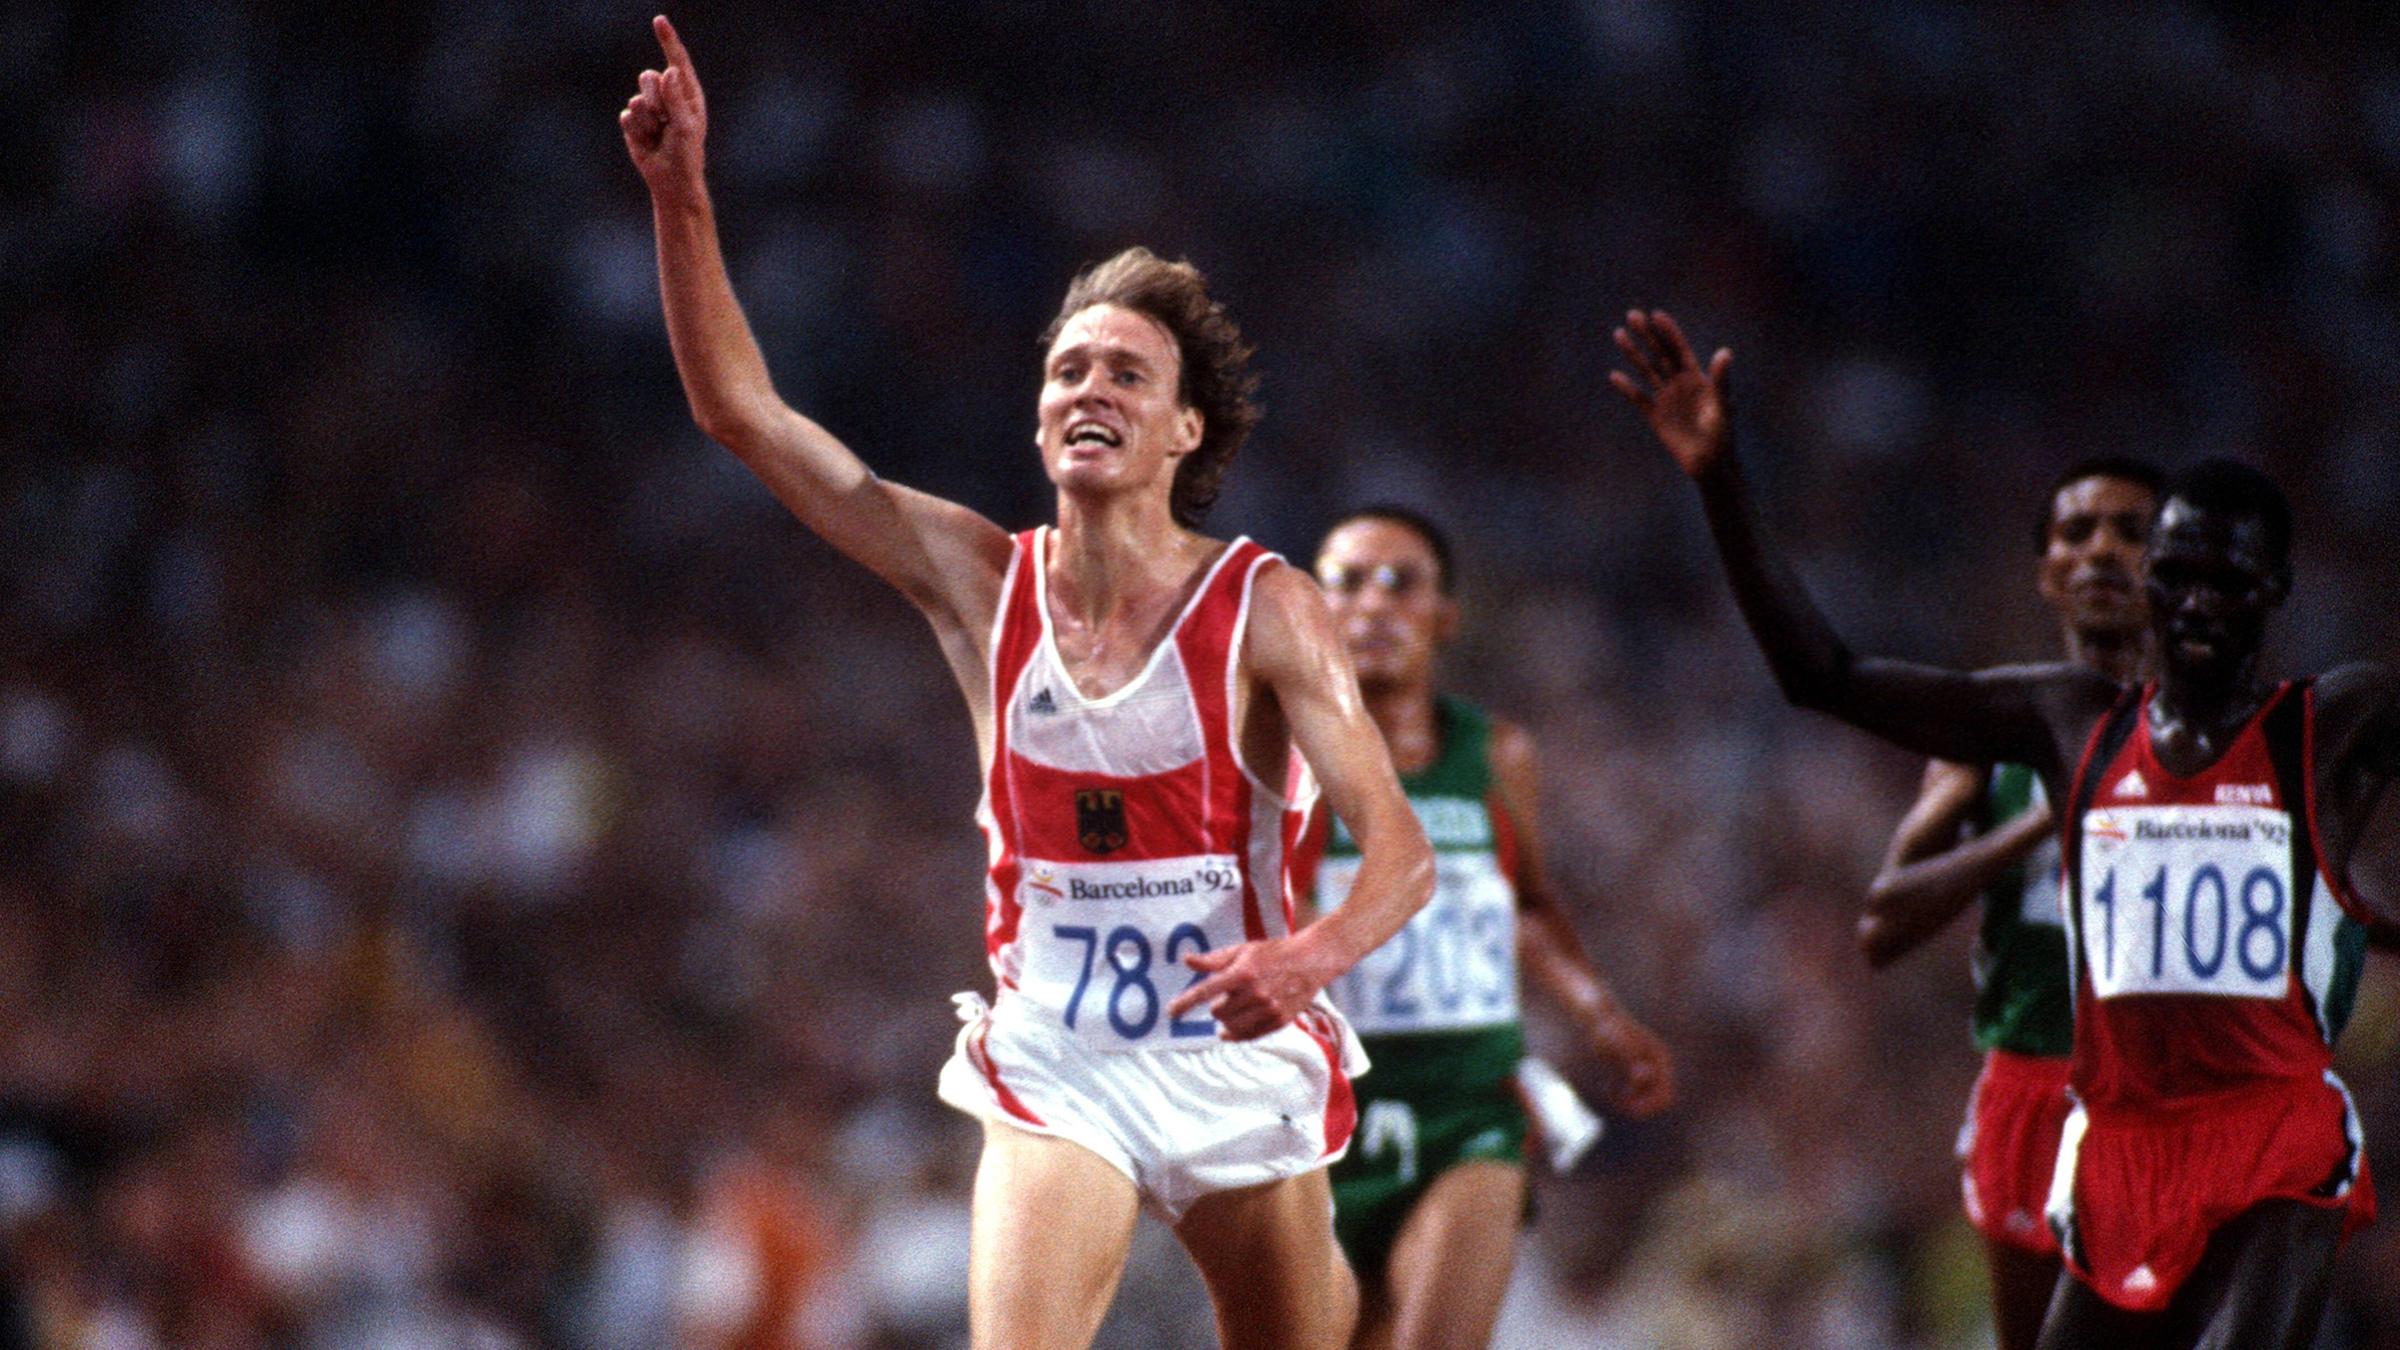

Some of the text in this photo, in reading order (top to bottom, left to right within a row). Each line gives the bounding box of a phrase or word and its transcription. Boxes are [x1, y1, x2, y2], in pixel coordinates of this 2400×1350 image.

[2136, 817, 2249, 840] Barcelona
[1070, 869, 1236, 900] Barcelona '92
[2095, 863, 2285, 981] 1108
[1053, 922, 1217, 1040] 782
